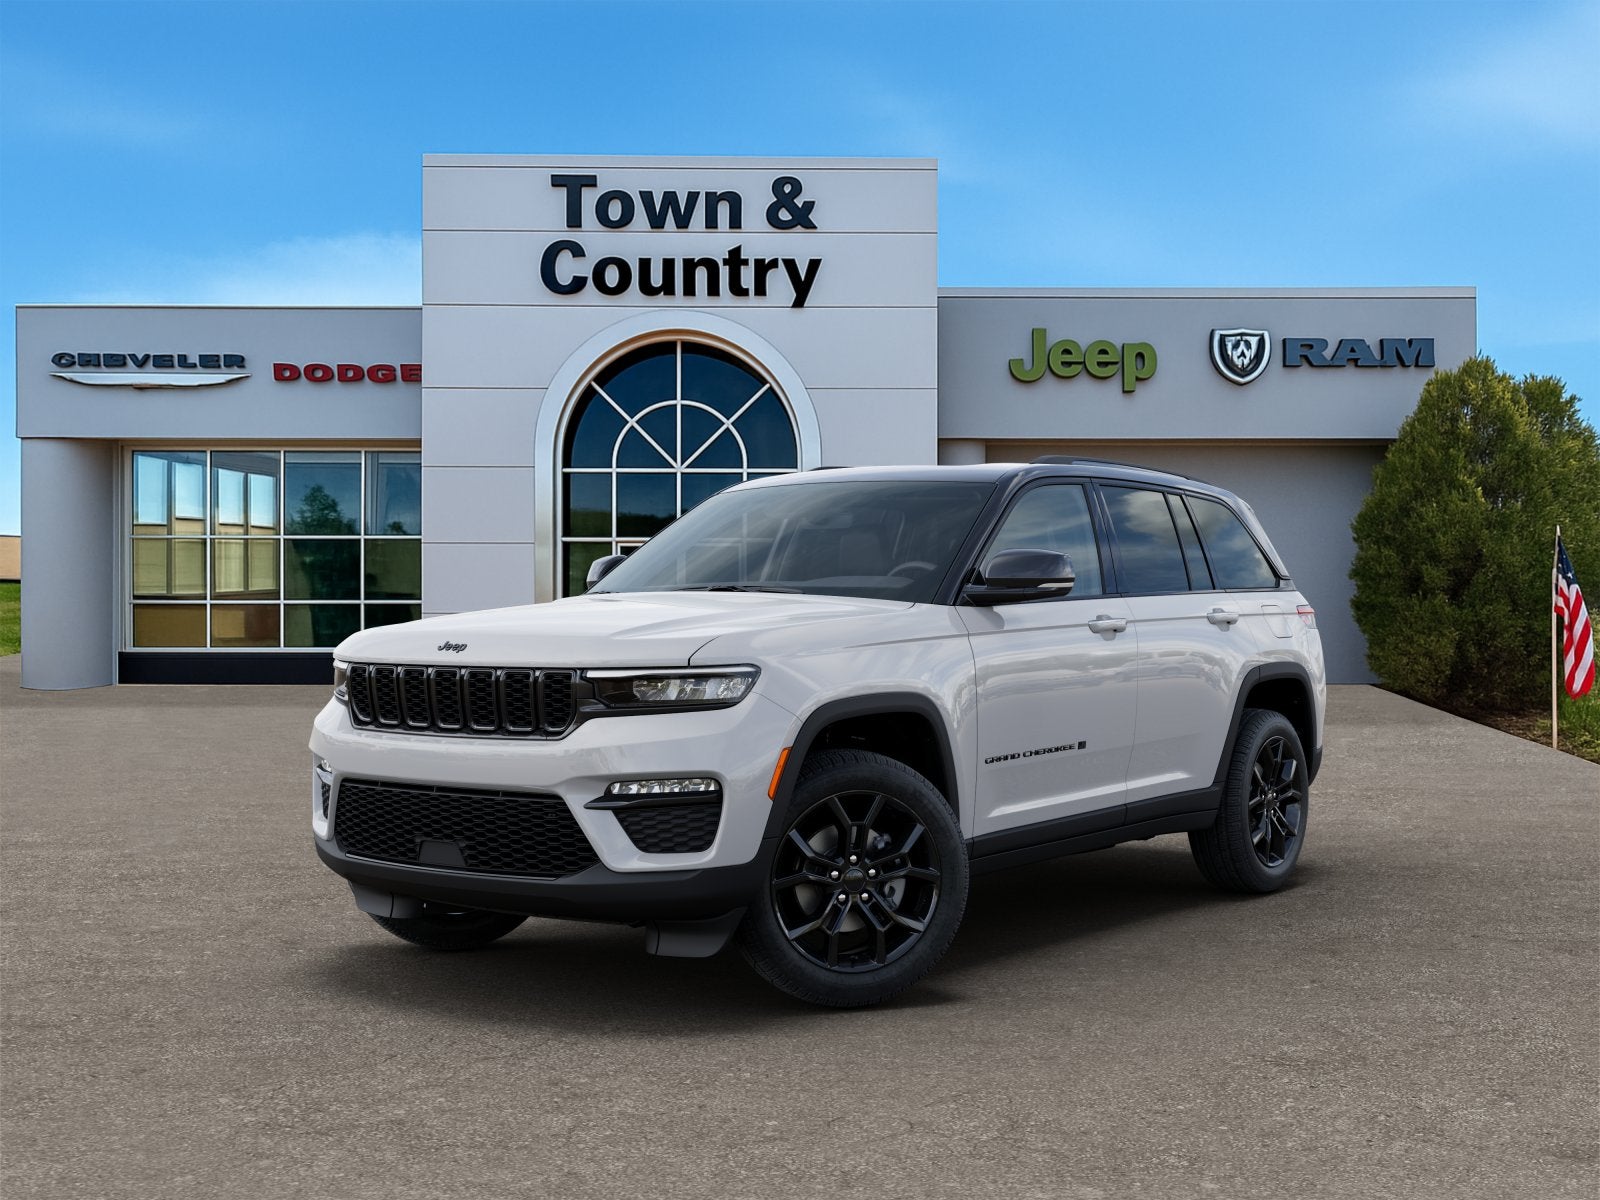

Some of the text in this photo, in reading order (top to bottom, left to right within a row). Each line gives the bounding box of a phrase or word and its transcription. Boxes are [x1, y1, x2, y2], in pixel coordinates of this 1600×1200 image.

[550, 174, 818, 229] Town &
[540, 239, 822, 308] Country
[1009, 328, 1157, 392] Jeep
[1283, 337, 1436, 367] RAM
[273, 363, 422, 382] DODGE
[437, 640, 468, 653] Jeep
[984, 743, 1076, 764] GRAND CHEROKEE
